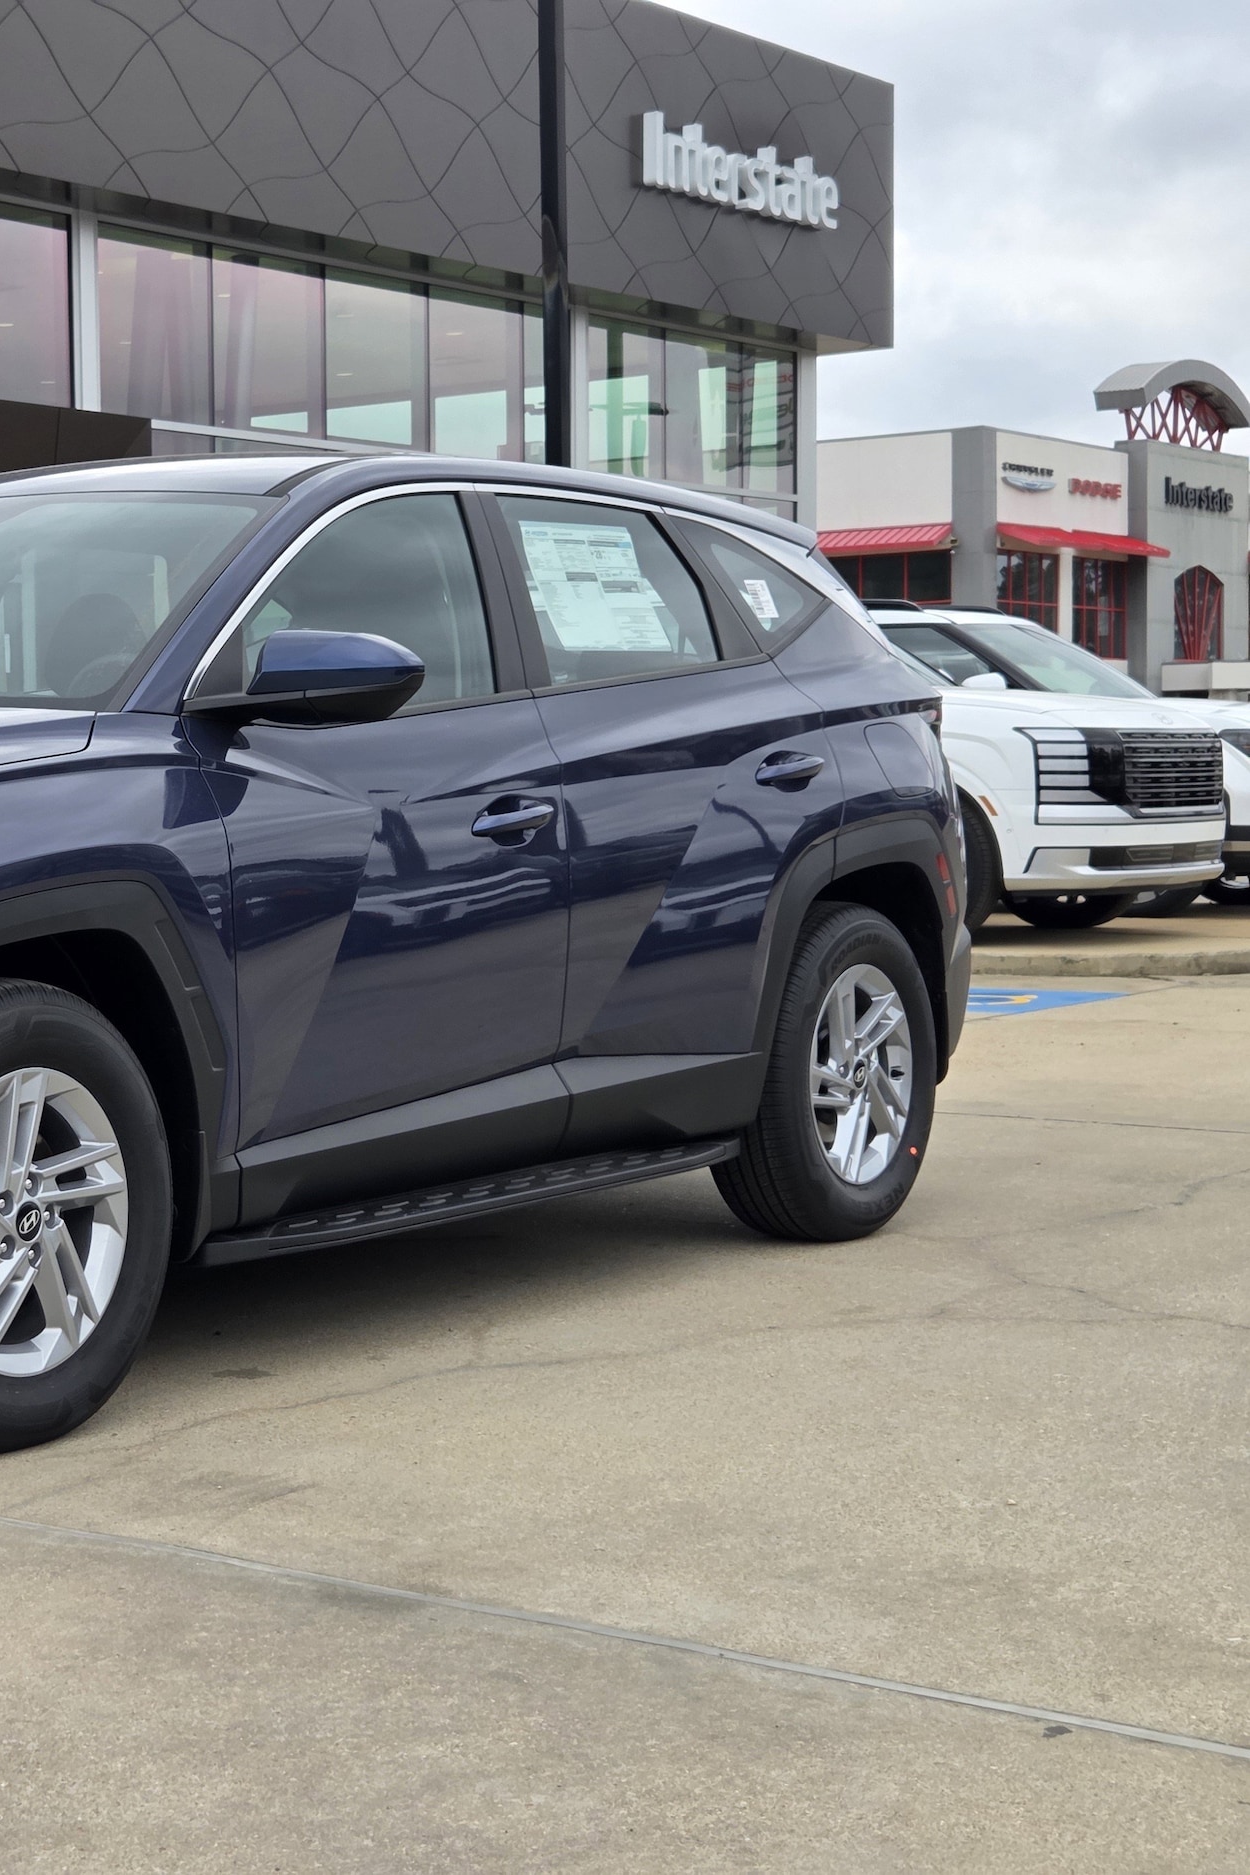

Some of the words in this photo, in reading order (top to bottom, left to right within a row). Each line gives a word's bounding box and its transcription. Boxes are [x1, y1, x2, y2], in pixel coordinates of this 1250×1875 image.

[643, 110, 839, 230] Interstate
[1068, 478, 1122, 500] DODGE
[1165, 476, 1234, 513] Interstate
